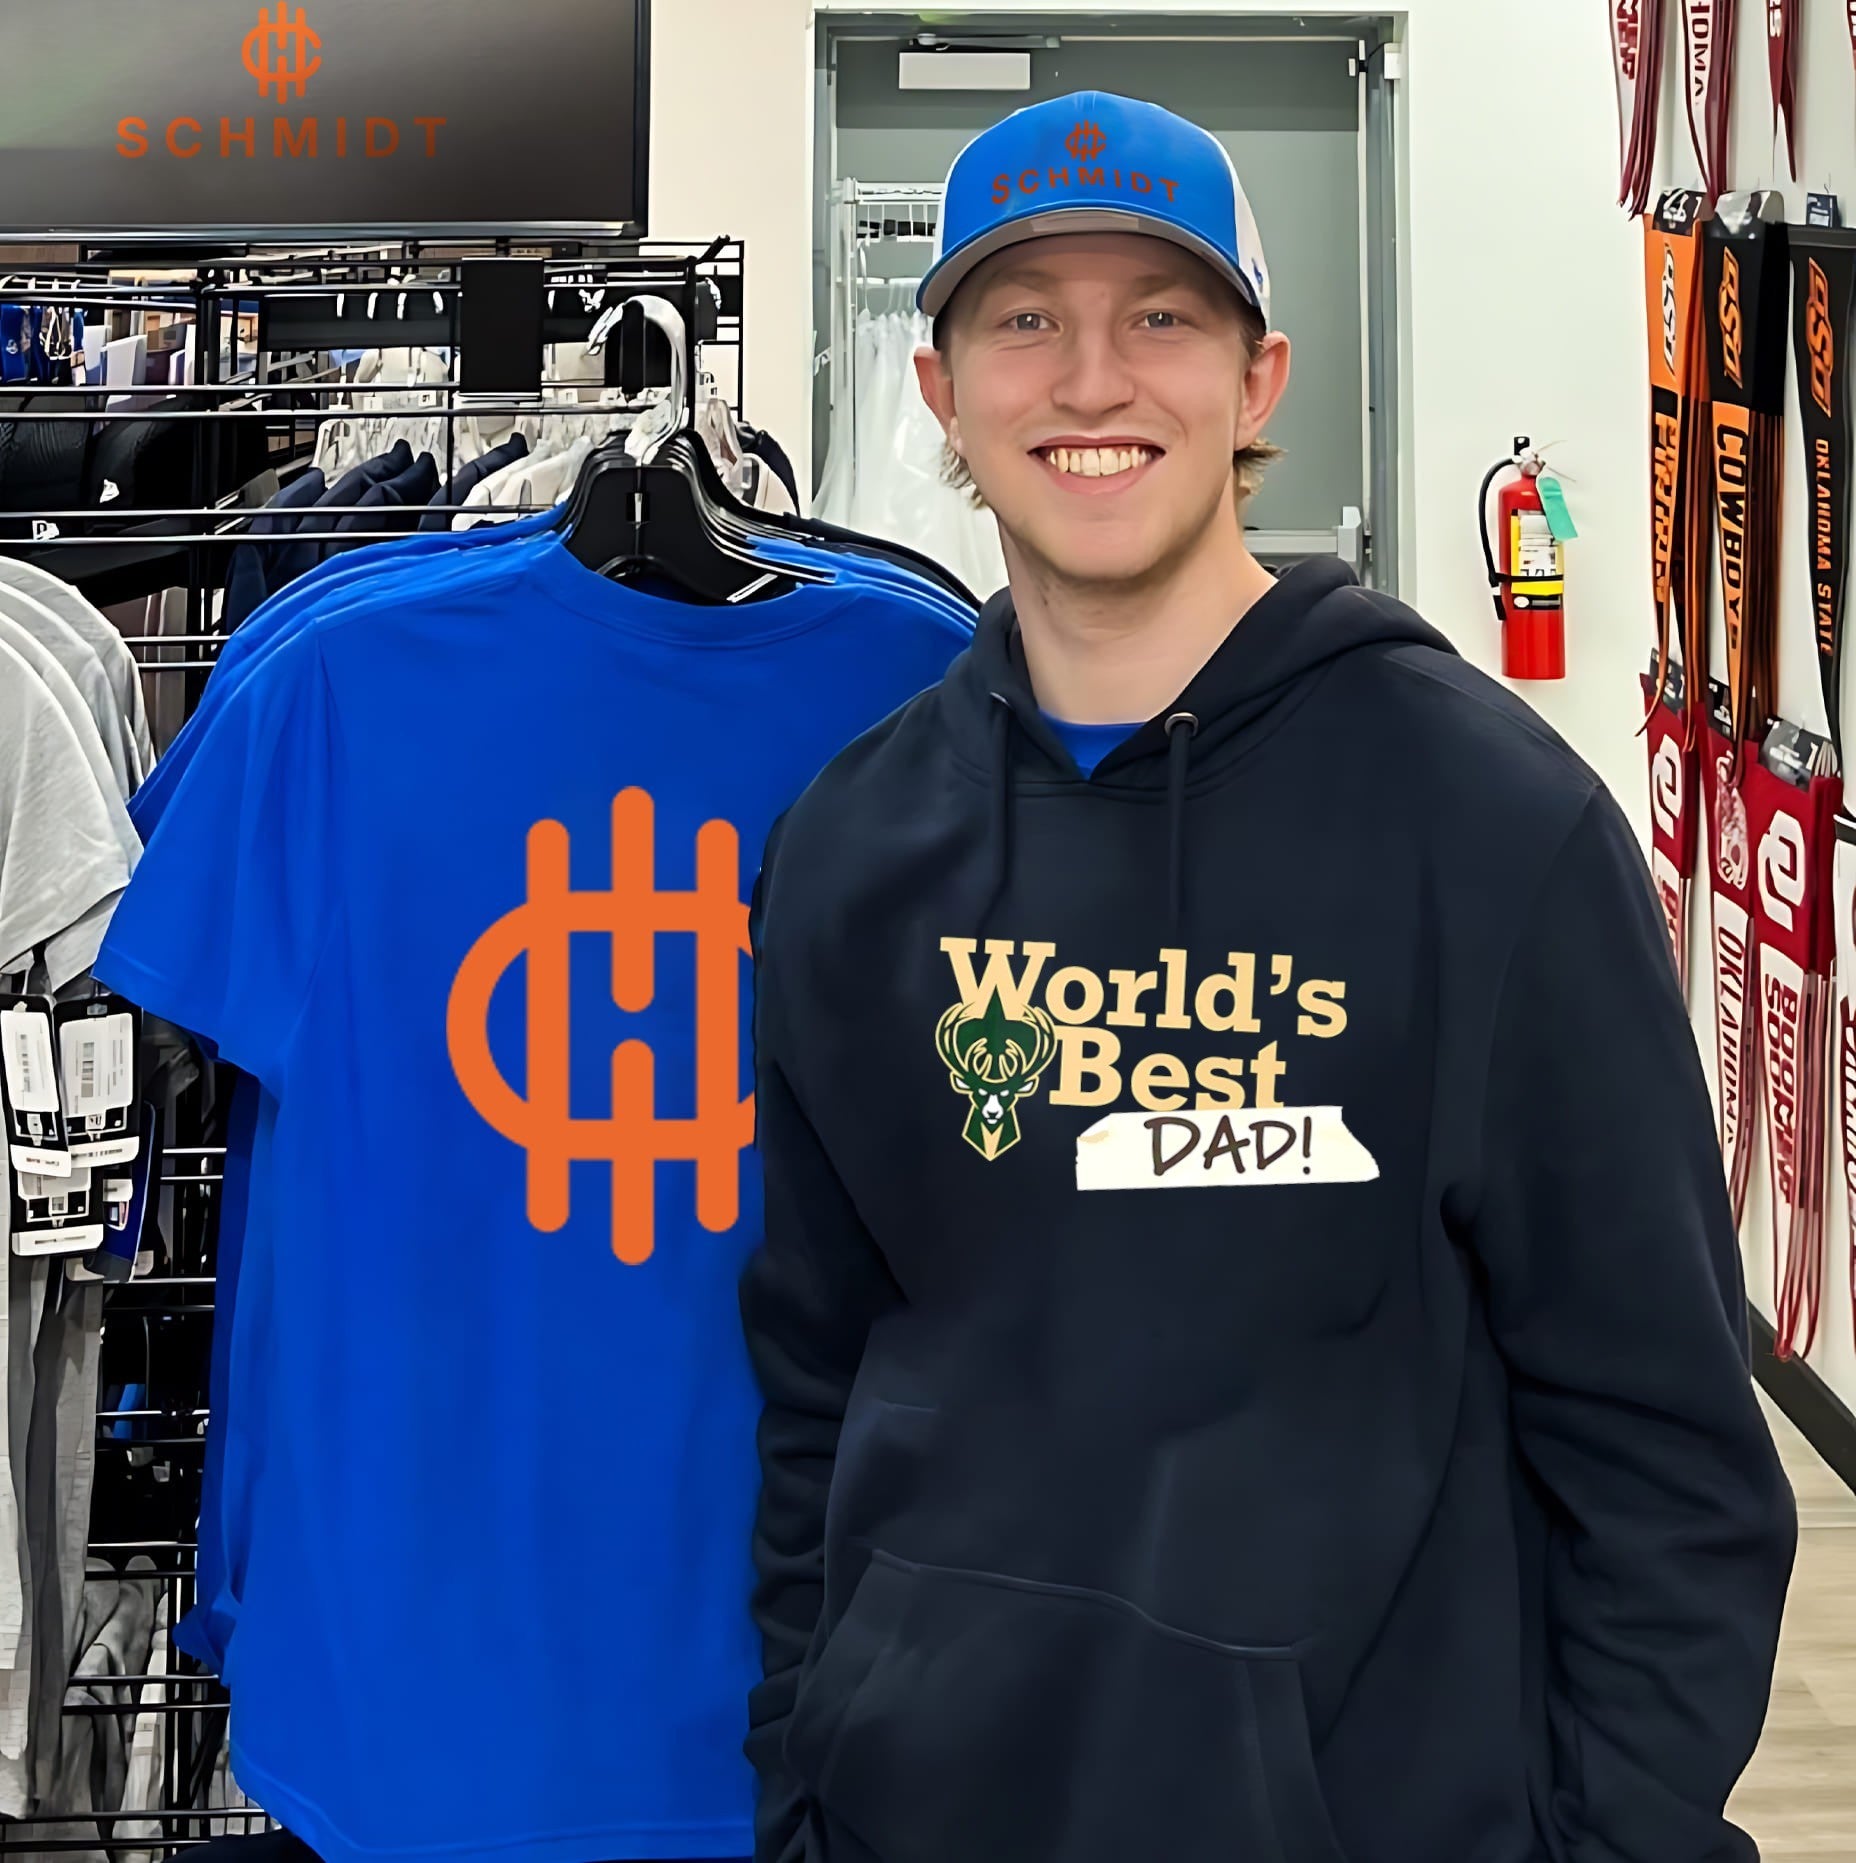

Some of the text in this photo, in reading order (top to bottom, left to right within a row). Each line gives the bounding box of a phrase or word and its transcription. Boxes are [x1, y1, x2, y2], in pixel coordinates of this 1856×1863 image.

[116, 116, 447, 158] SCHMIDT
[992, 167, 1179, 204] SCHMIDT
[1815, 439, 1832, 570] OKLAHOMA
[940, 937, 1347, 1038] World's
[1049, 1025, 1286, 1111] Best
[1144, 1115, 1312, 1176] DAD!
